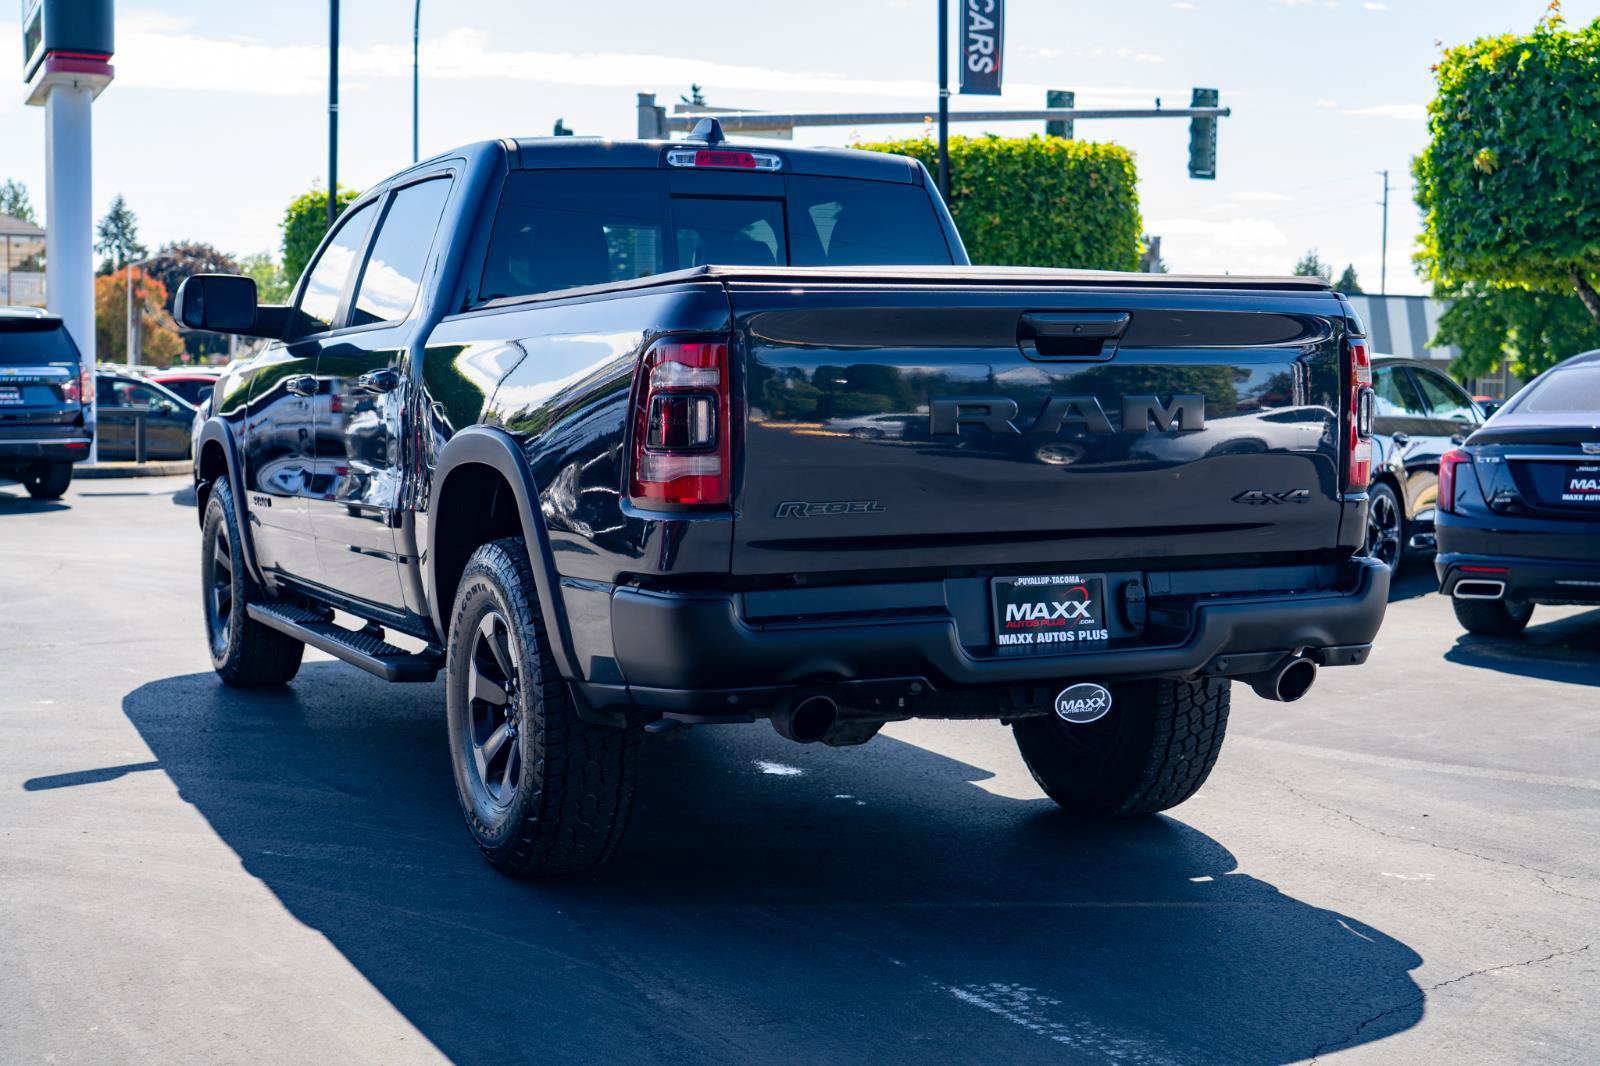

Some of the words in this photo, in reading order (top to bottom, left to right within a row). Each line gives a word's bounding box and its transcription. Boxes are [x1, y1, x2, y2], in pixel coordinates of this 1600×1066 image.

[928, 393, 1208, 436] RAM
[1569, 478, 1600, 490] MA
[1005, 600, 1092, 622] MAXX
[1006, 619, 1040, 628] AUTOS
[1040, 618, 1066, 627] PLUS
[999, 633, 1034, 645] MAXX
[1037, 630, 1075, 643] AUTOS
[1078, 629, 1109, 641] PLUS
[1060, 697, 1106, 711] MAXX
